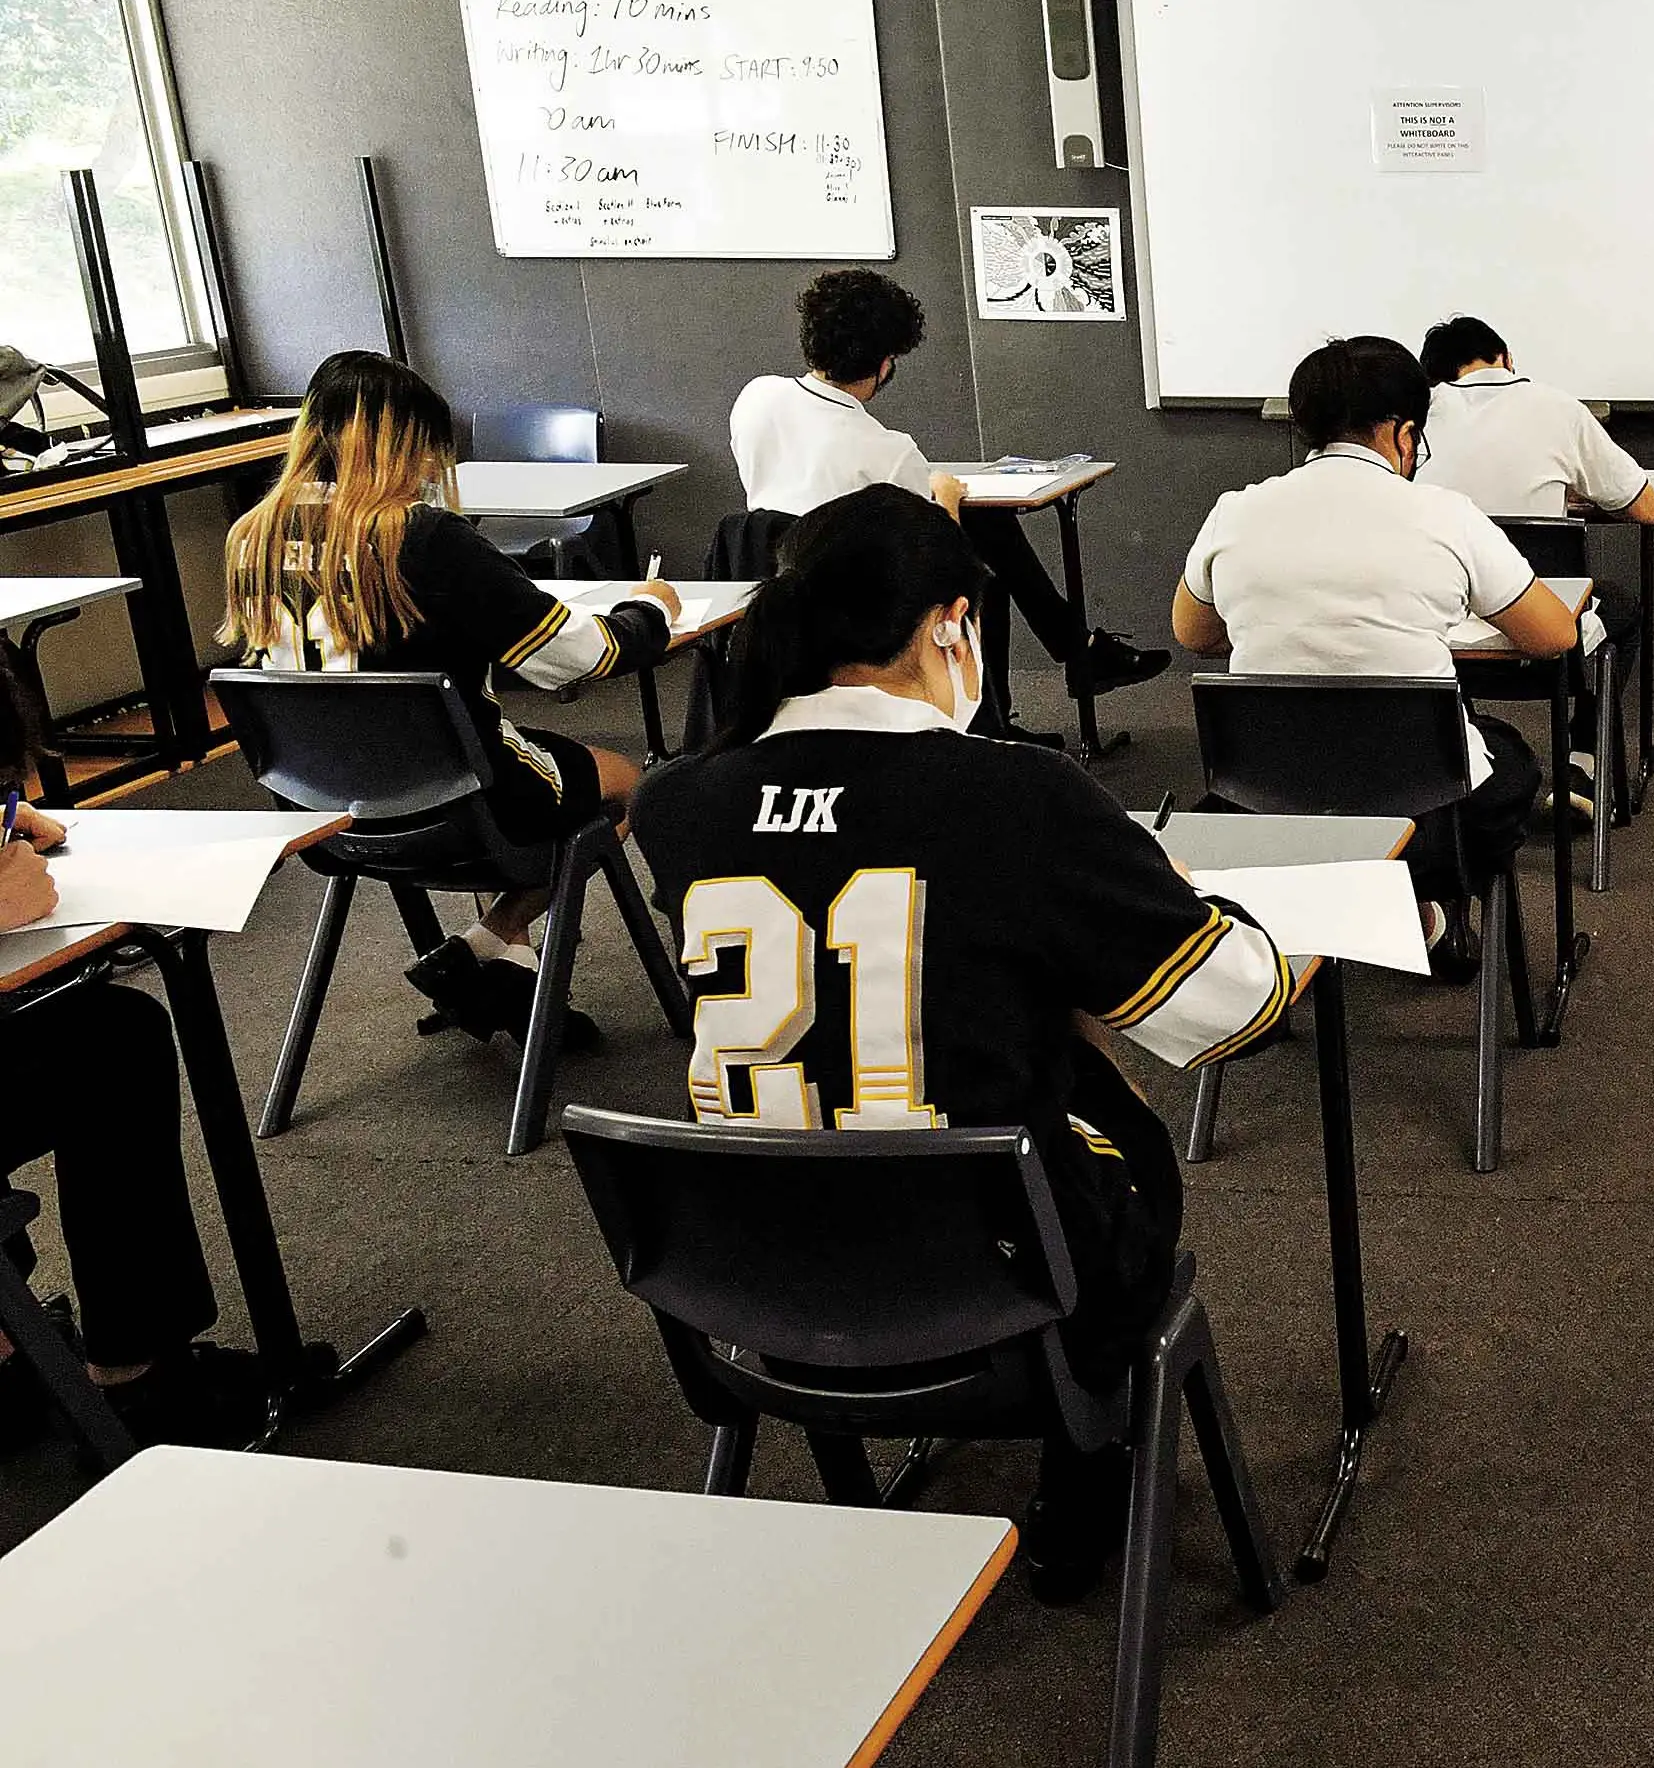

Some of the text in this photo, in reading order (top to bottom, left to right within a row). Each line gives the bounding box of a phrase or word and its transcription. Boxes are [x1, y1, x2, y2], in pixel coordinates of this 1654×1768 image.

[614, 0, 648, 19] 10
[654, 3, 711, 21] mins
[1400, 116, 1455, 125] THIS IS NOT A
[753, 785, 844, 833] LJX
[681, 866, 948, 1130] 21
